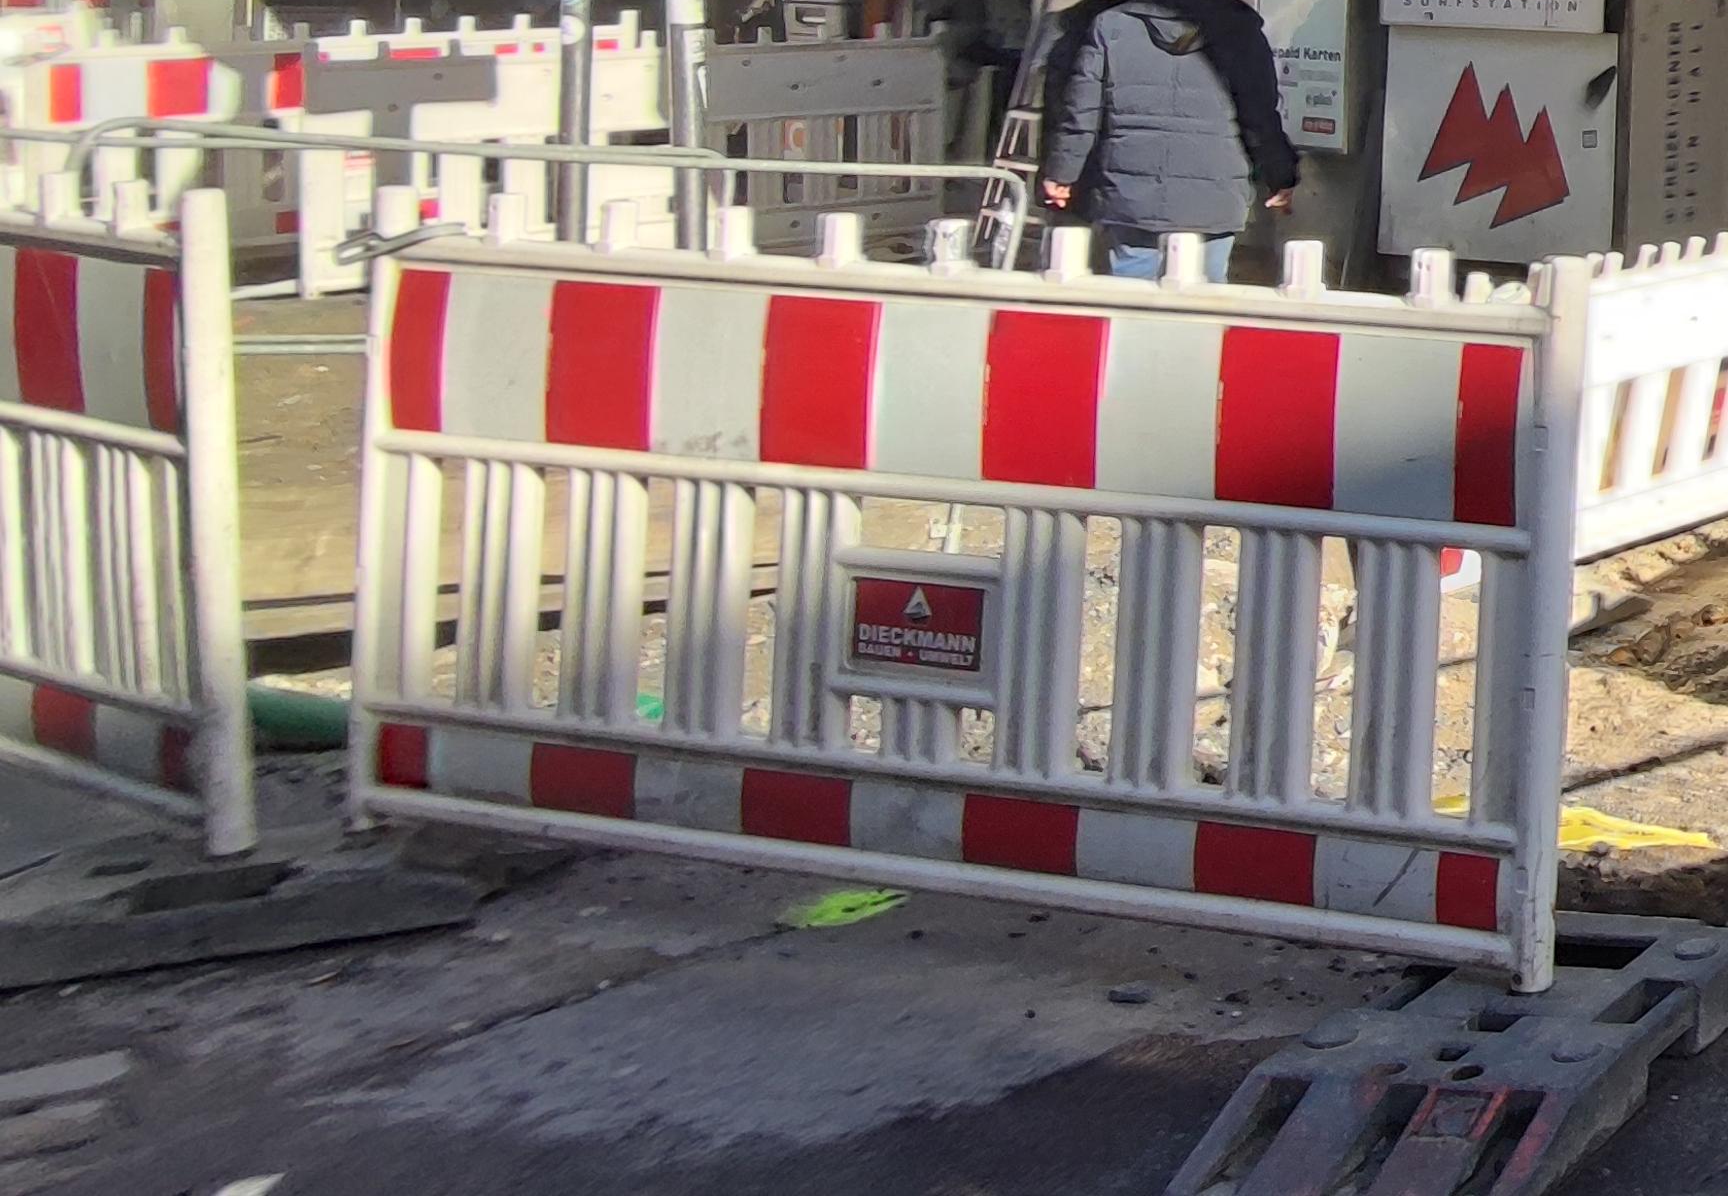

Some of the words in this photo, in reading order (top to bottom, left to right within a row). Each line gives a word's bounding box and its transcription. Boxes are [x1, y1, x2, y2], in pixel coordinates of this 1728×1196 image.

[1303, 47, 1342, 62] Karten
[858, 623, 977, 652] DIECKMANN
[857, 641, 901, 658] BAUEN
